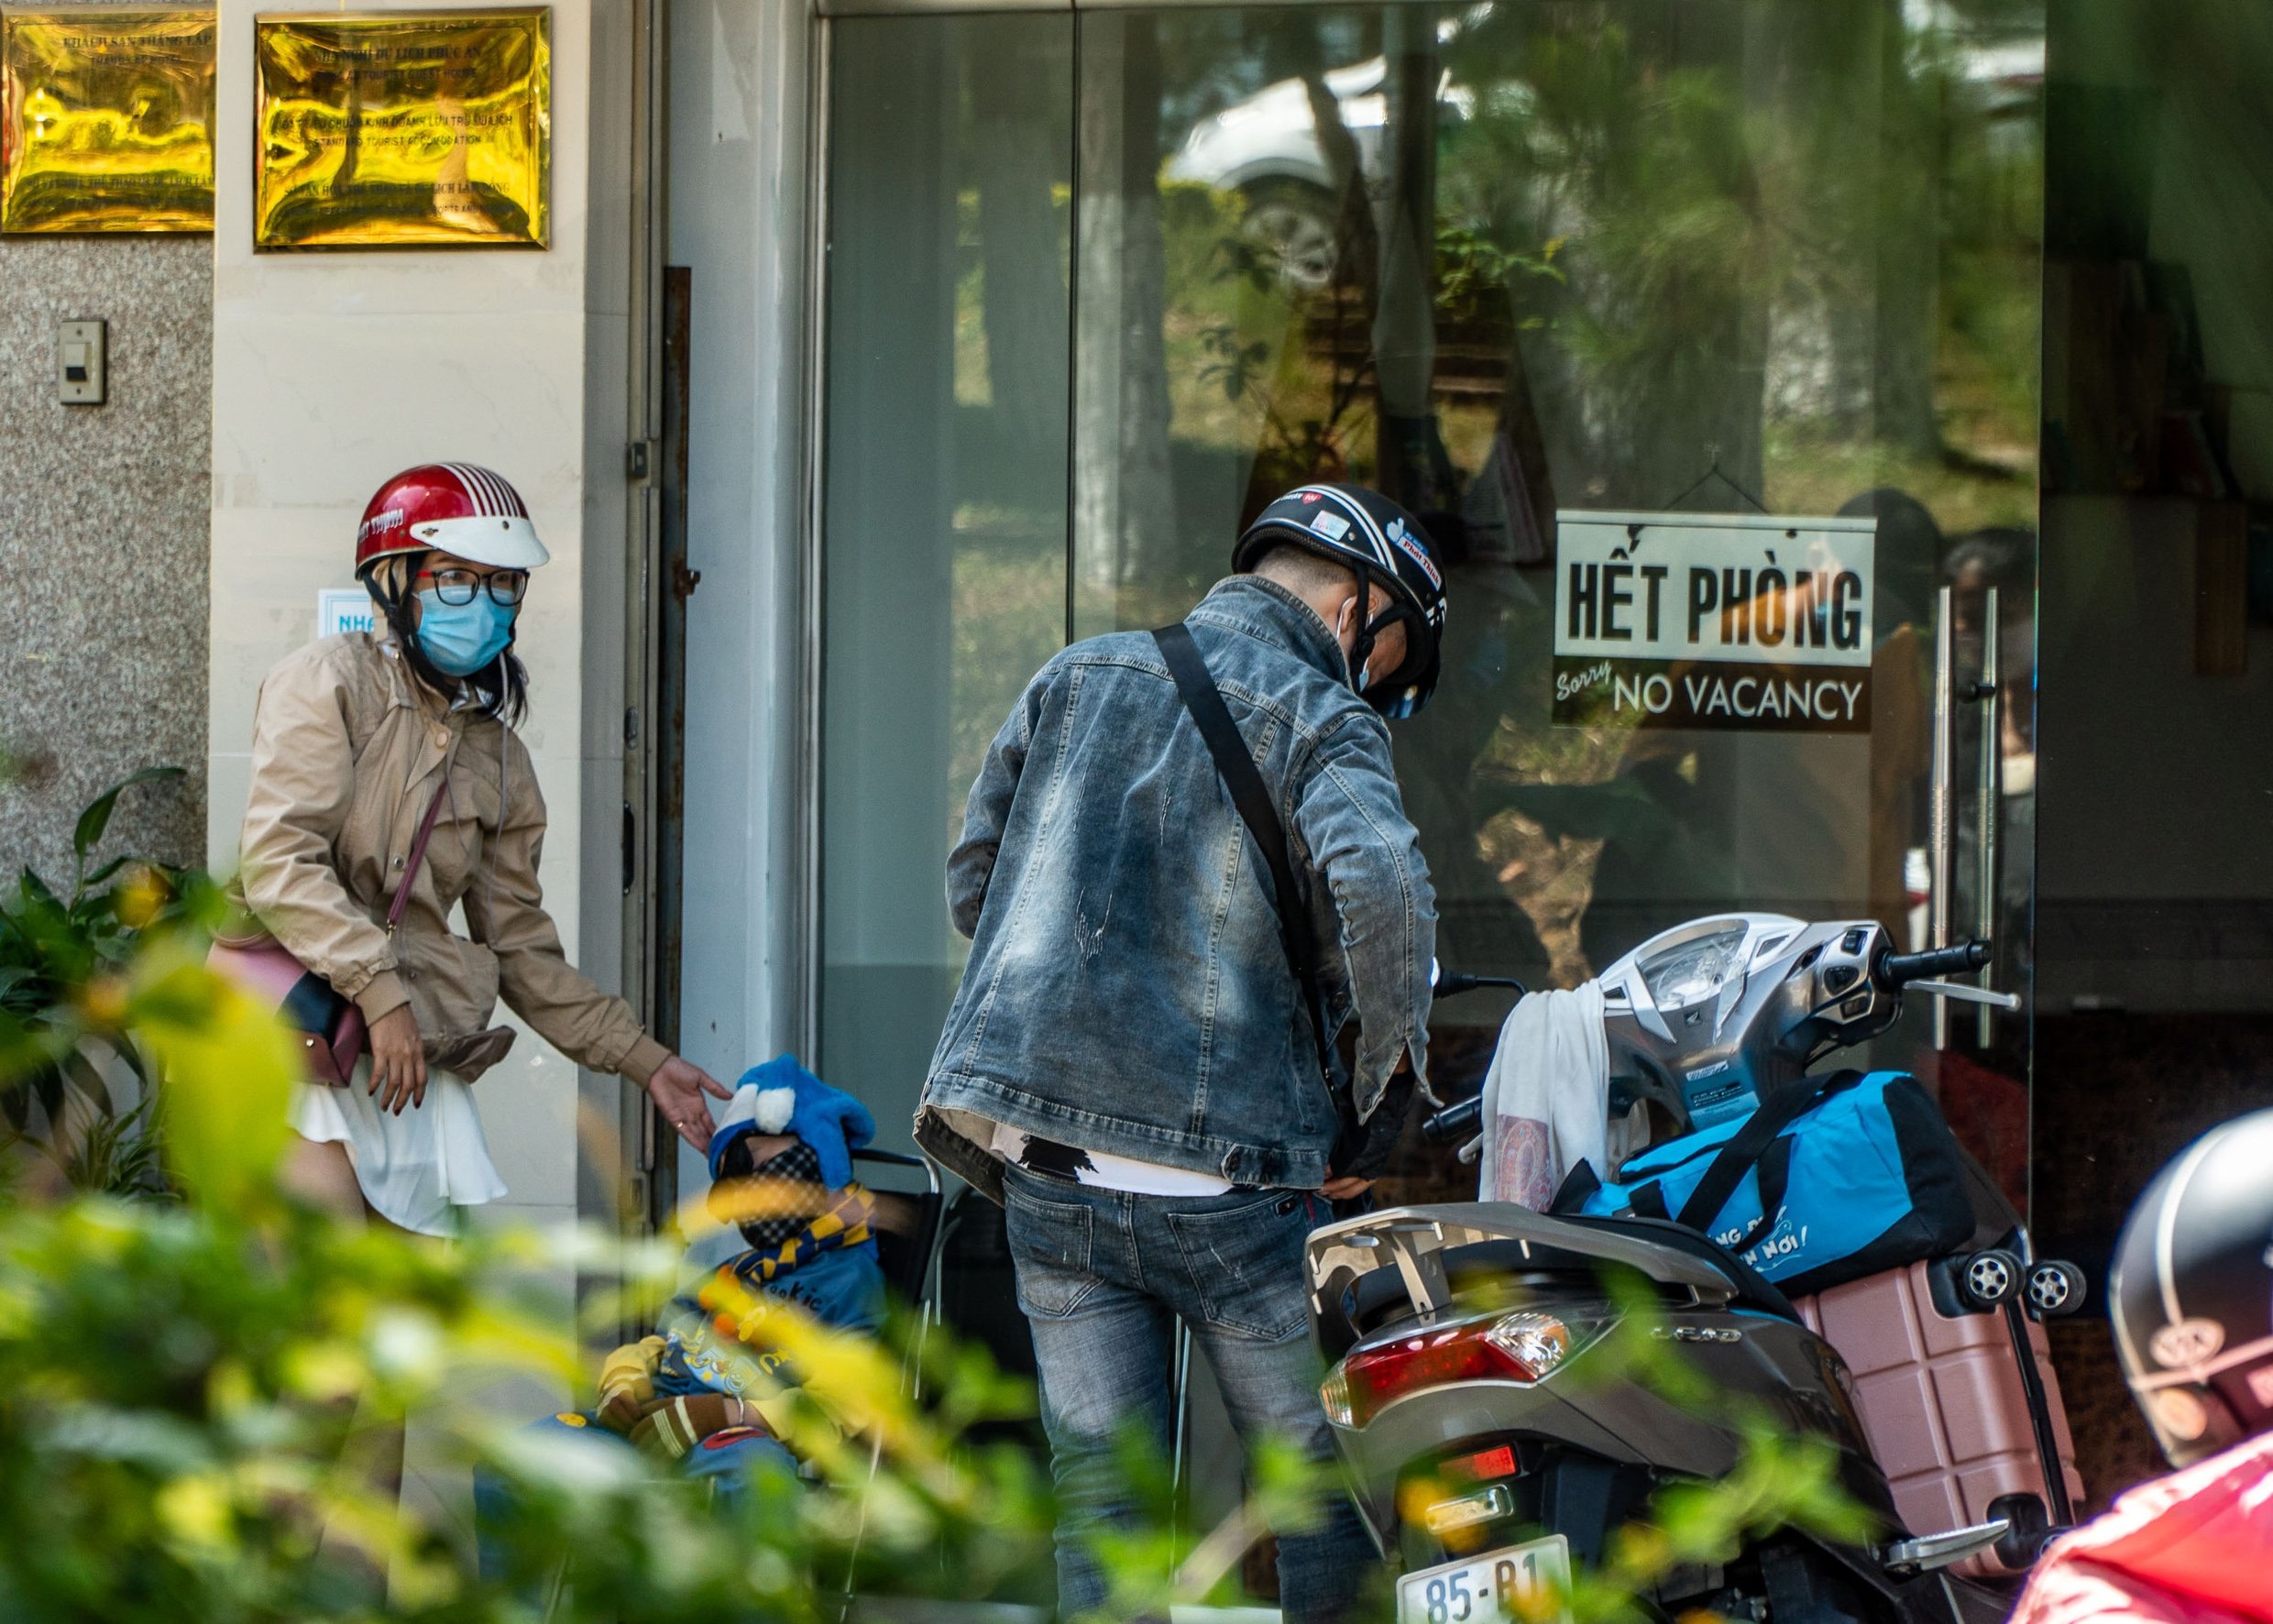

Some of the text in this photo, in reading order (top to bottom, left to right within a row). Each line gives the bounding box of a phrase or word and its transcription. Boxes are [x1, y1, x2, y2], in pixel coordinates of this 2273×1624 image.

[1568, 539, 1862, 651] HẾT PHÒNG
[1556, 659, 1862, 721] Sorry NO VACANCY
[1708, 1228, 1741, 1245] NG
